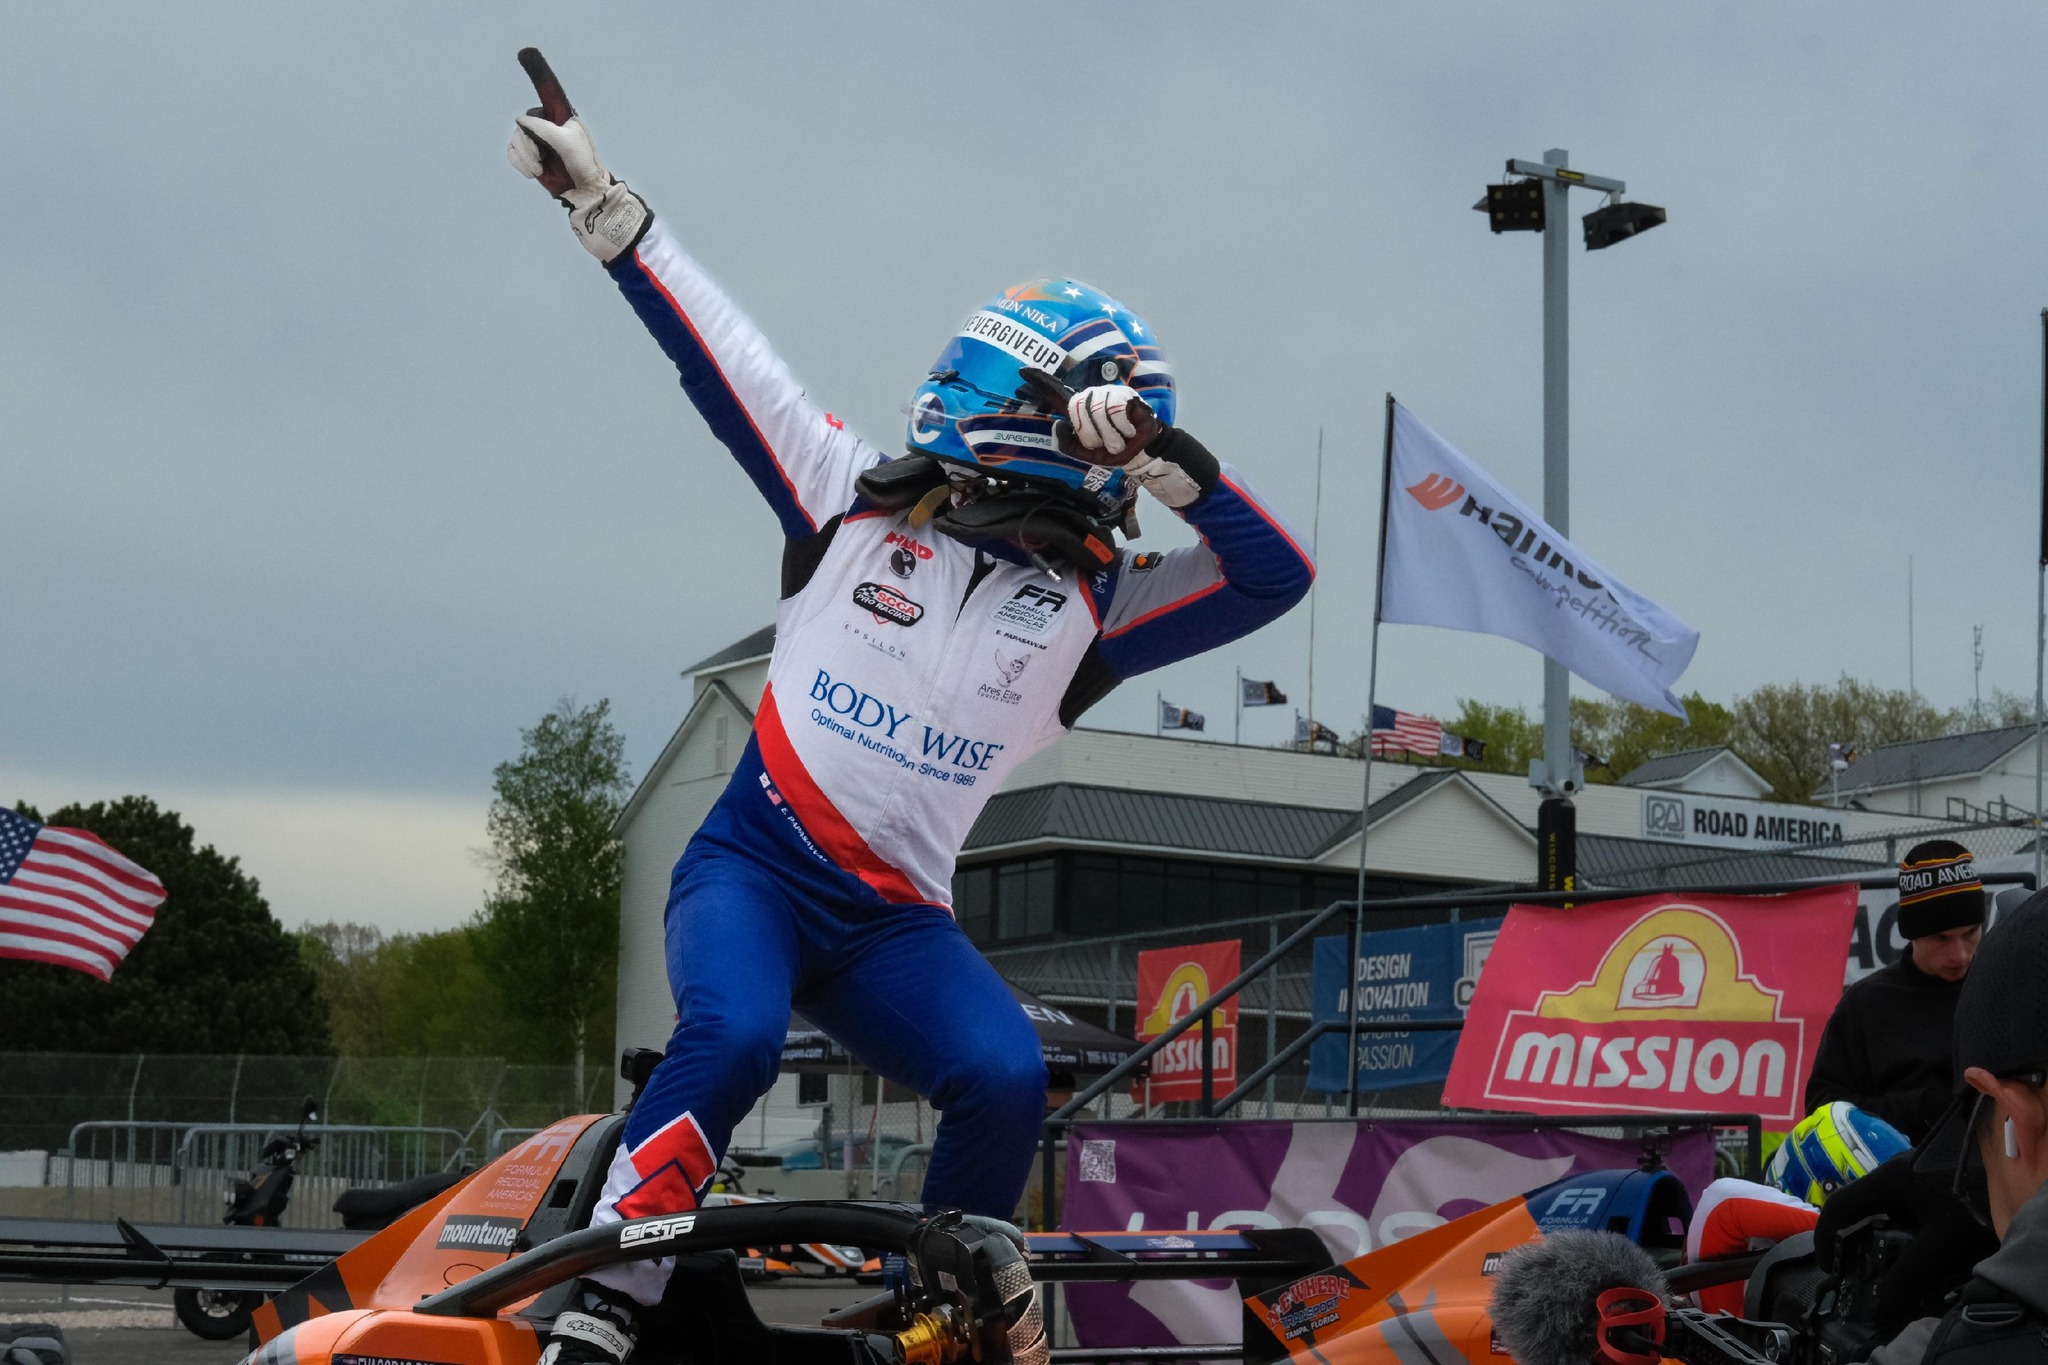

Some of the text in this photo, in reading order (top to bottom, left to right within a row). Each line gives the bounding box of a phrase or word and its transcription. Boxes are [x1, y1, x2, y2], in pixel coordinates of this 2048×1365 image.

[855, 593, 911, 621] PRO RACING
[876, 592, 915, 617] SCCA
[1006, 600, 1053, 618] FORMULA
[997, 611, 1046, 629] AMERICAS
[1001, 606, 1048, 624] REGIONAL
[980, 683, 1022, 701] Ares Elite
[809, 668, 913, 740] BODY
[811, 708, 977, 787] Optimal Nutrition Since 1989
[1694, 808, 1843, 845] ROAD AMERICA
[1899, 872, 1933, 892] ROAD
[1358, 953, 1411, 981] DESIGN
[503, 1164, 552, 1176] FORMULA
[494, 1177, 541, 1189] REGIONAL
[487, 1189, 536, 1201] AMERICAS
[1539, 1216, 1589, 1224] FORMULA
[438, 1220, 517, 1247] mountune
[1280, 1294, 1341, 1329] TRANSPORT
[1310, 1312, 1340, 1330] FLORIDA
